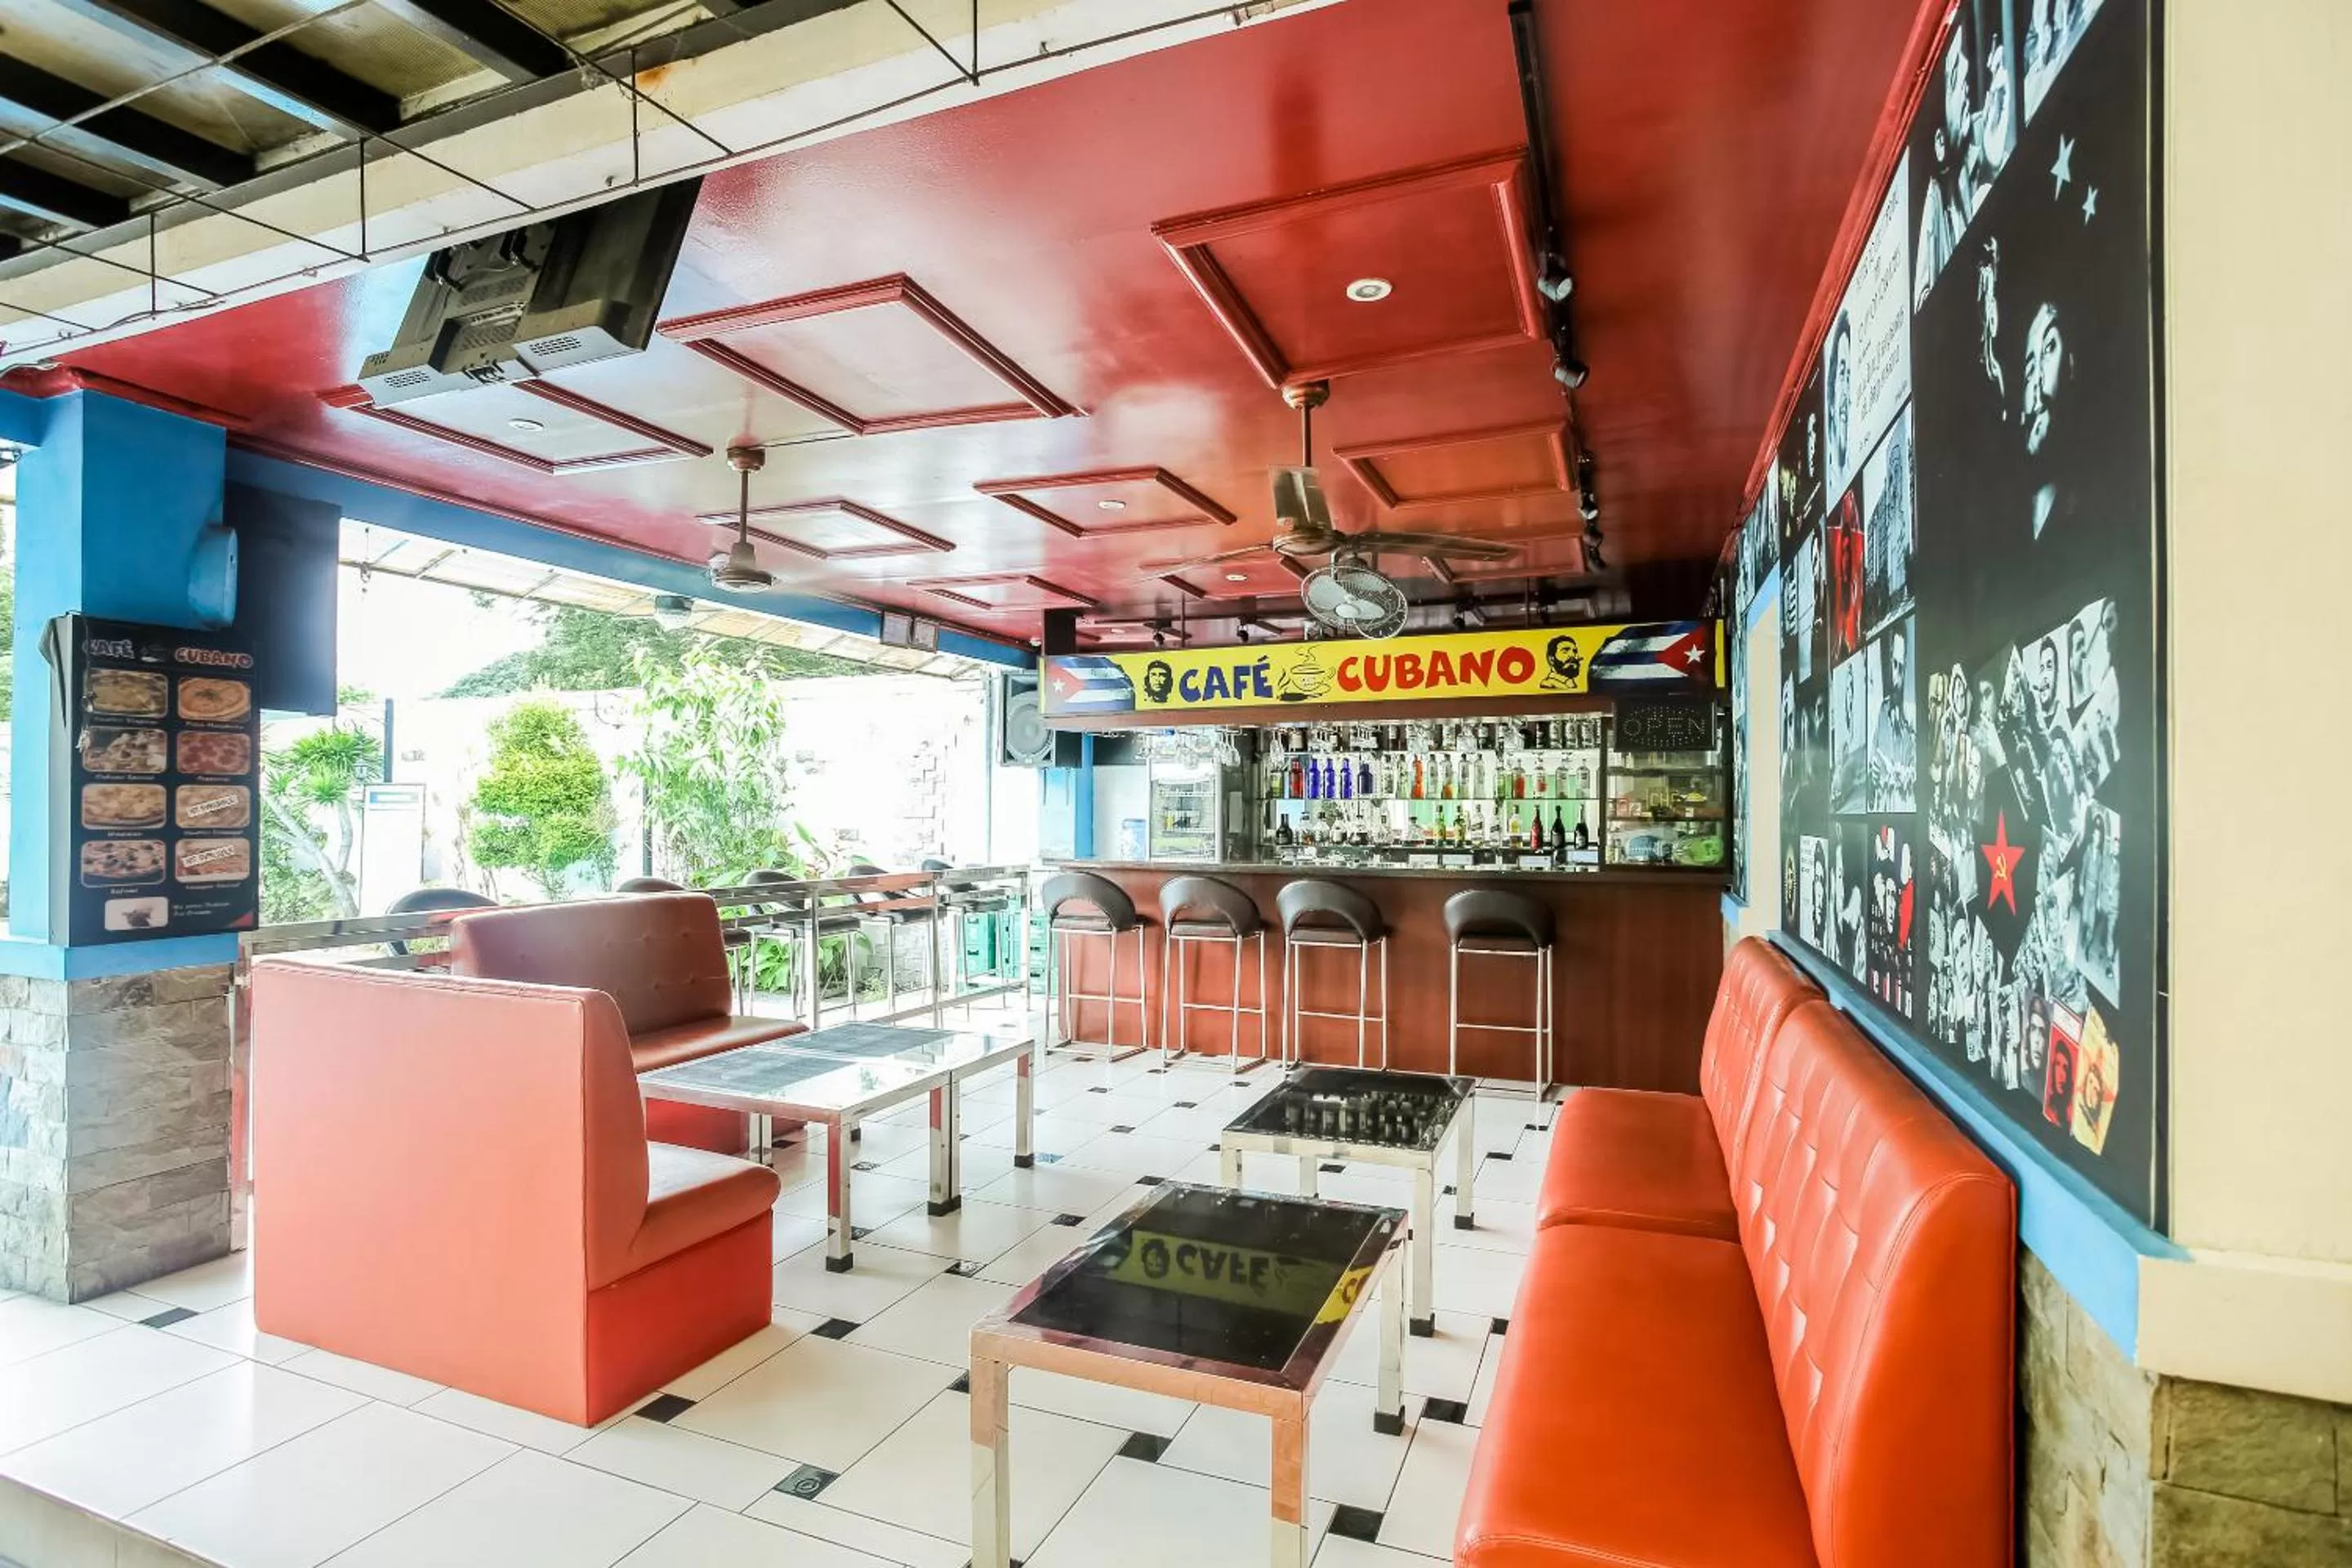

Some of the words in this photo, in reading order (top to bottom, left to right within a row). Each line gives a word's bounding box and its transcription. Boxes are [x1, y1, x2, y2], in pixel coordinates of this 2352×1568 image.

[175, 647, 253, 669] CUBANO
[1178, 655, 1273, 702] CAFÉ
[1337, 646, 1536, 693] CUBANO
[1624, 717, 1705, 736] OPEN
